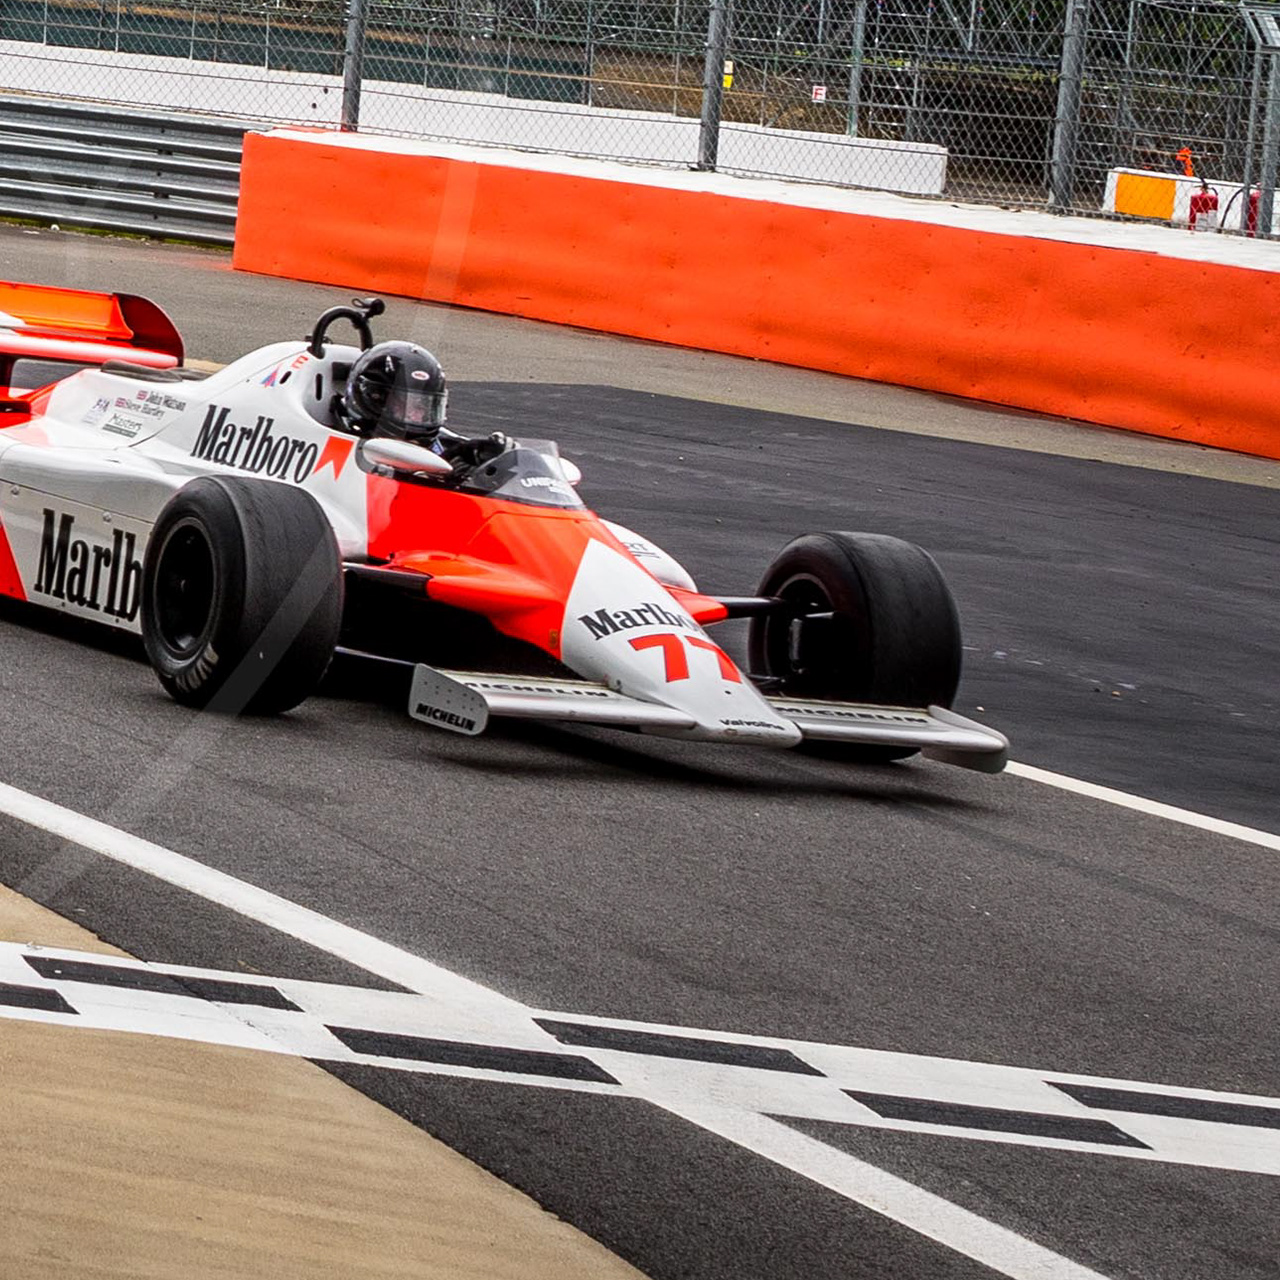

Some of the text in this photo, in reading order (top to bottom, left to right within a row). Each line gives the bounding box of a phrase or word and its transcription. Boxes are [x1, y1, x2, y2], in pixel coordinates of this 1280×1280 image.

[190, 404, 319, 484] Marlboro
[627, 632, 743, 685] 77
[415, 702, 477, 732] MICHELIN
[773, 706, 929, 724] MICHELIN
